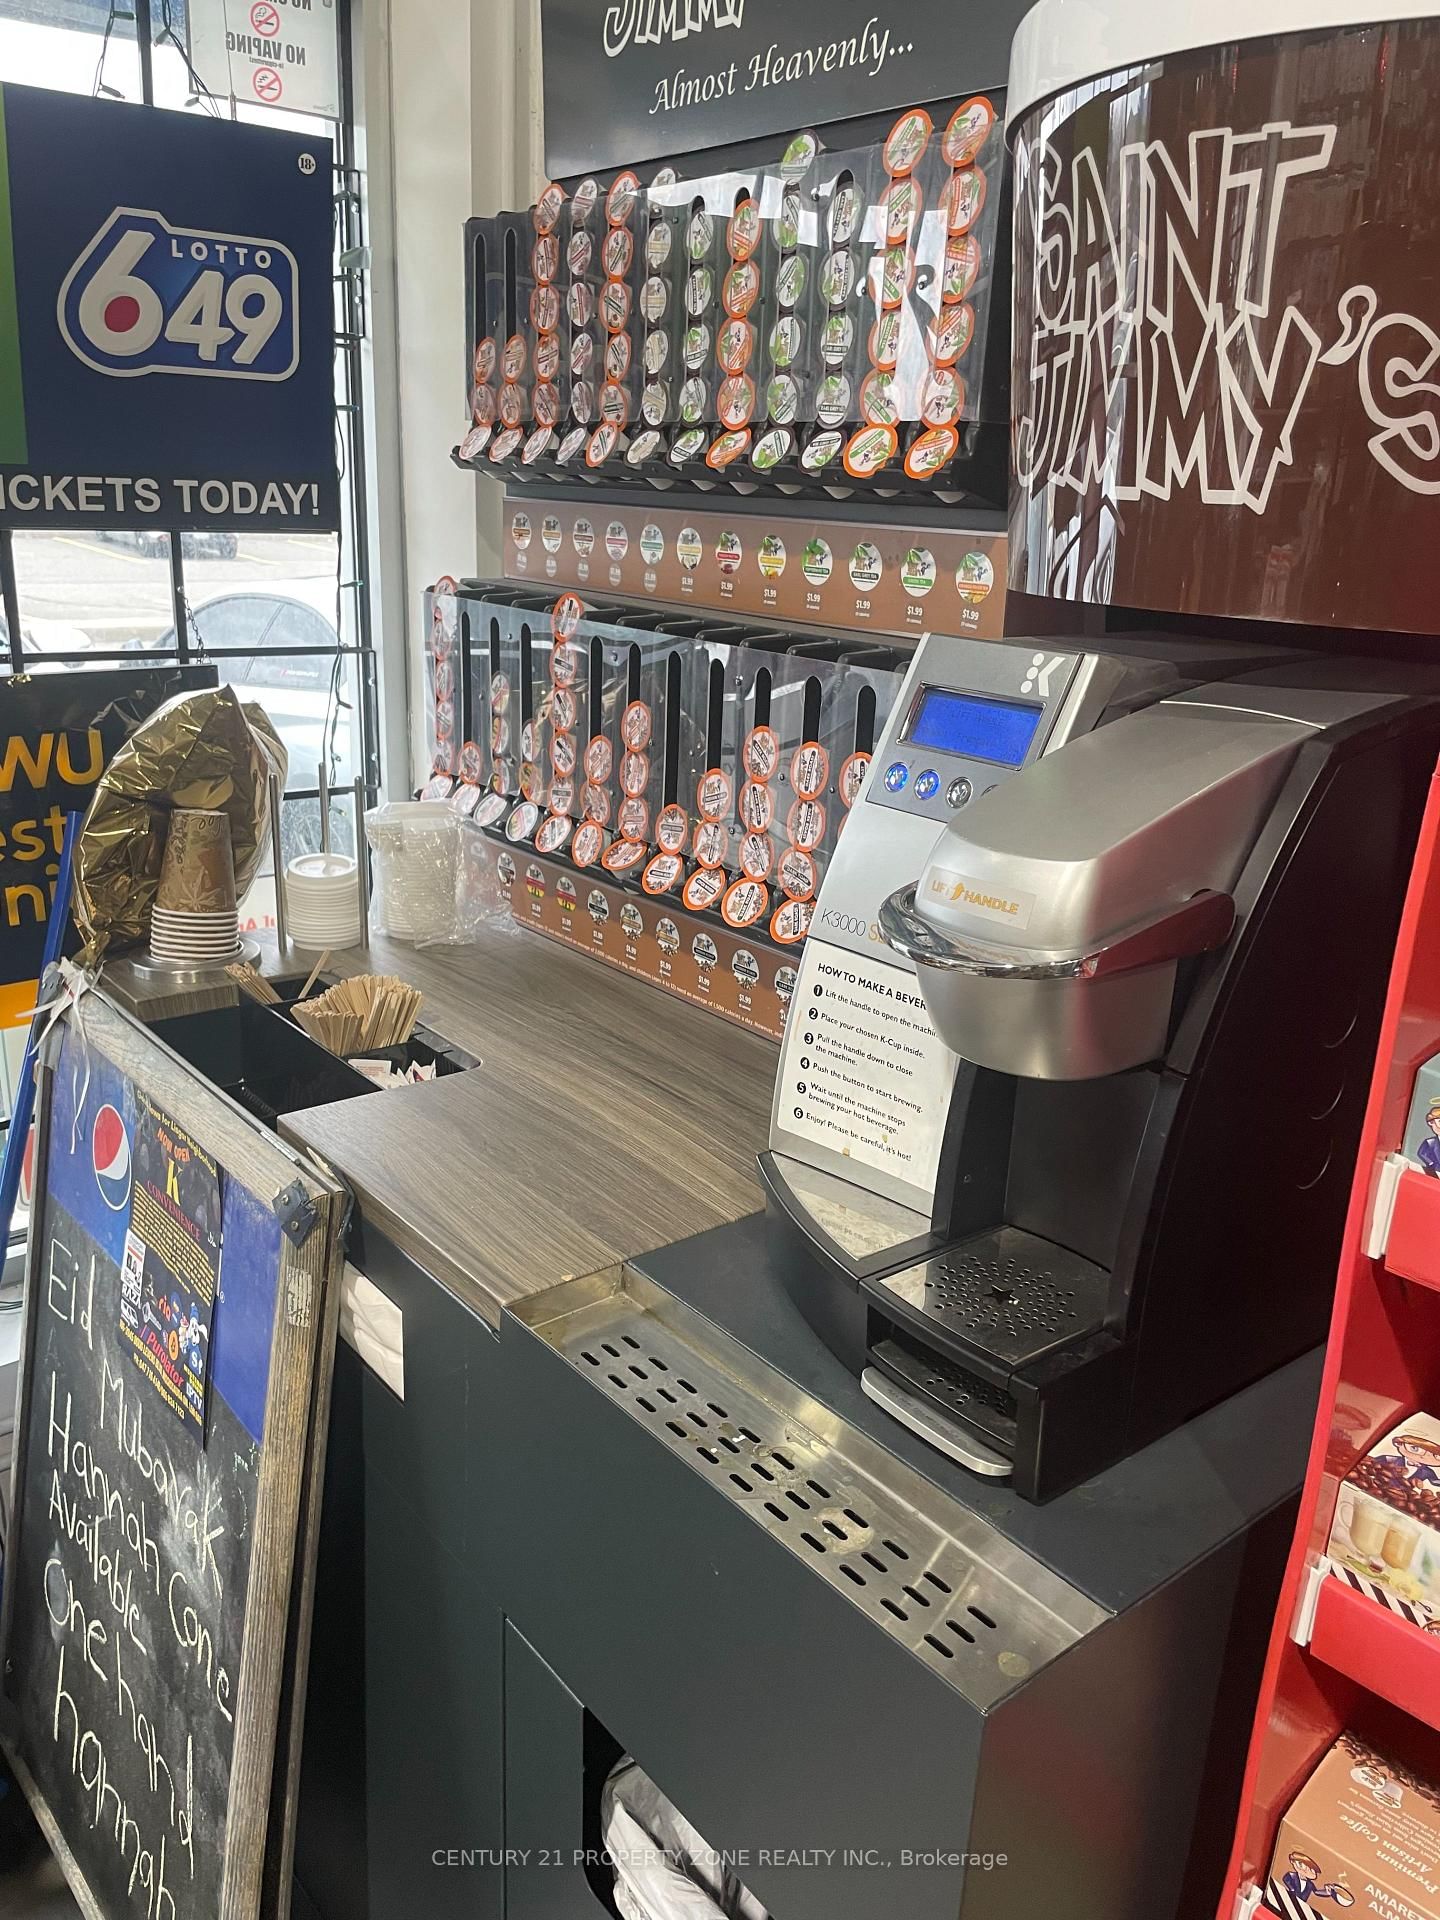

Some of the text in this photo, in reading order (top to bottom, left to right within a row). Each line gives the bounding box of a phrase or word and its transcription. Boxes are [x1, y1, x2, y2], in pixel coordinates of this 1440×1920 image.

[649, 17, 914, 115] Almost Heavenly...
[1030, 121, 1337, 331] SAINT
[170, 238, 272, 269] LOTTO
[1019, 285, 1440, 515] JIMMY'S
[173, 479, 321, 516] TODAY!
[764, 588, 776, 598] $1.99
[807, 593, 820, 602] $1.99
[856, 600, 870, 609] $1.99
[907, 606, 922, 616] $1.99
[962, 609, 979, 620] $1.99
[963, 888, 1020, 915] HANDLE
[820, 907, 866, 937] K3000
[626, 944, 636, 955] $1.99
[660, 960, 671, 971] $1.99
[698, 975, 710, 986] $1.99
[739, 994, 752, 1005] $1.99
[817, 962, 927, 1010] HOW TO MAKE A BEVER
[826, 989, 837, 999] Lift
[838, 995, 848, 1003] the
[850, 998, 871, 1012] handle
[873, 1008, 880, 1016] to
[882, 1013, 898, 1022] open
[900, 1018, 911, 1027] the
[821, 1012, 838, 1024] Place
[839, 1021, 854, 1031] your
[856, 1027, 879, 1040] chosen
[880, 1035, 902, 1050] K-Cup
[903, 1044, 926, 1059] inside.
[816, 1045, 858, 1066] the machine.
[817, 1034, 830, 1043] Pull
[831, 1040, 842, 1048] the
[844, 1043, 865, 1057] handle
[867, 1053, 885, 1065] down
[896, 1065, 913, 1076] close
[811, 1082, 827, 1095] Wait
[828, 1090, 843, 1100] until
[844, 1096, 856, 1105] the
[857, 1102, 886, 1118] machine
[888, 1114, 906, 1126] stops
[813, 1062, 828, 1074] Push
[830, 1070, 841, 1079] the
[842, 1074, 865, 1088] button
[875, 1089, 892, 1099] start
[894, 1095, 923, 1114] brewing.
[809, 1093, 899, 1134] brewing your hot beverage.
[156, 1127, 173, 1153] NOW
[806, 1113, 826, 1126] Enjoy!
[827, 1121, 849, 1135] Please
[850, 1130, 858, 1139] be
[860, 1135, 884, 1151] careful,
[886, 1146, 896, 1154] it's
[897, 1150, 911, 1161] hot!
[147, 1180, 201, 1242] CONVENIENCE
[48, 1237, 97, 1350] Eid
[146, 1332, 185, 1386] Purolator
[49, 1468, 147, 1656] Available
[168, 1571, 233, 1722] Cone
[44, 1558, 194, 1880] One hand
[1339, 1814, 1379, 1843] Coffee
[1375, 1849, 1440, 1895] Premium
[1382, 1840, 1433, 1873] Artisan
